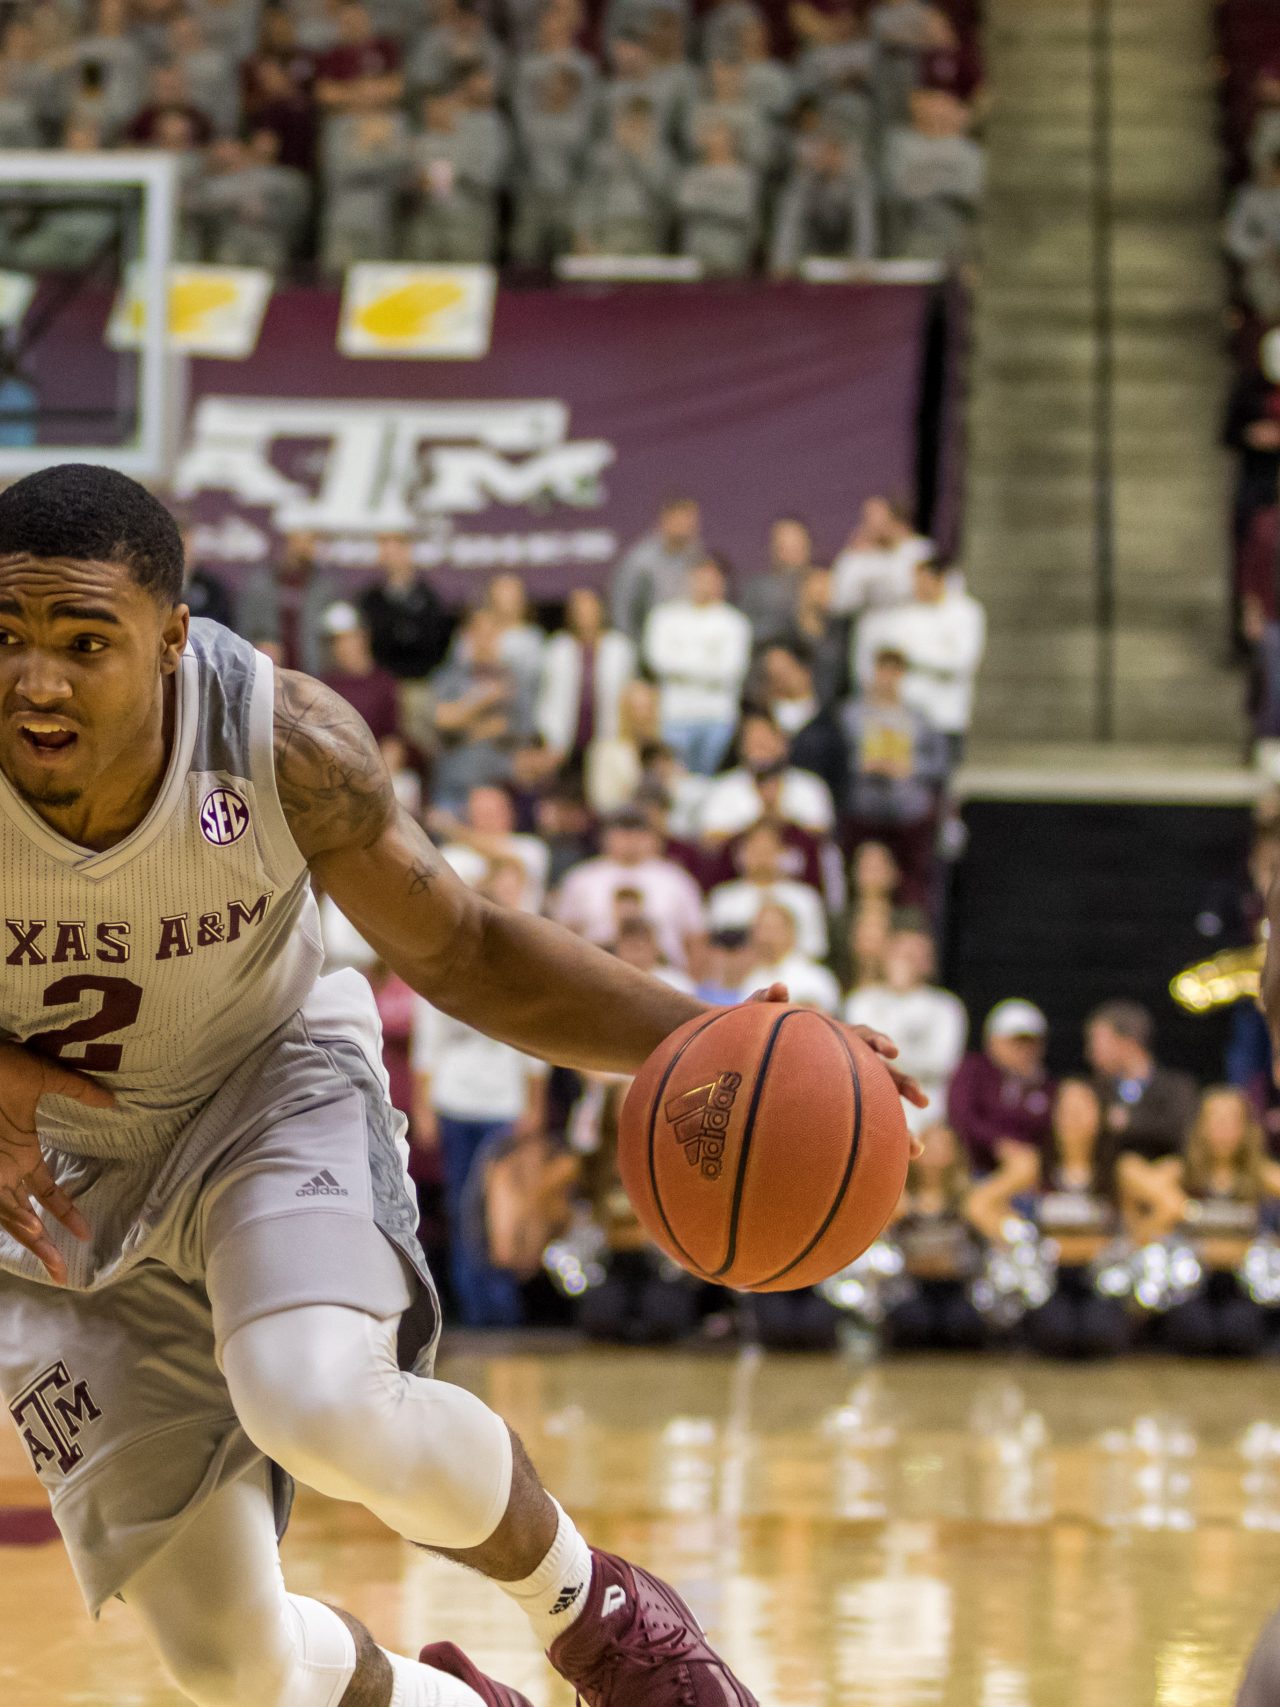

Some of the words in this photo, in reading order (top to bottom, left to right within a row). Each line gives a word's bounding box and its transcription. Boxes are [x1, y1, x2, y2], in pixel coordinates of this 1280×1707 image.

[202, 792, 246, 843] SEC
[155, 890, 274, 961] A&M
[23, 973, 144, 1072] 2
[700, 1071, 742, 1181] adidas
[295, 1185, 349, 1197] adidas
